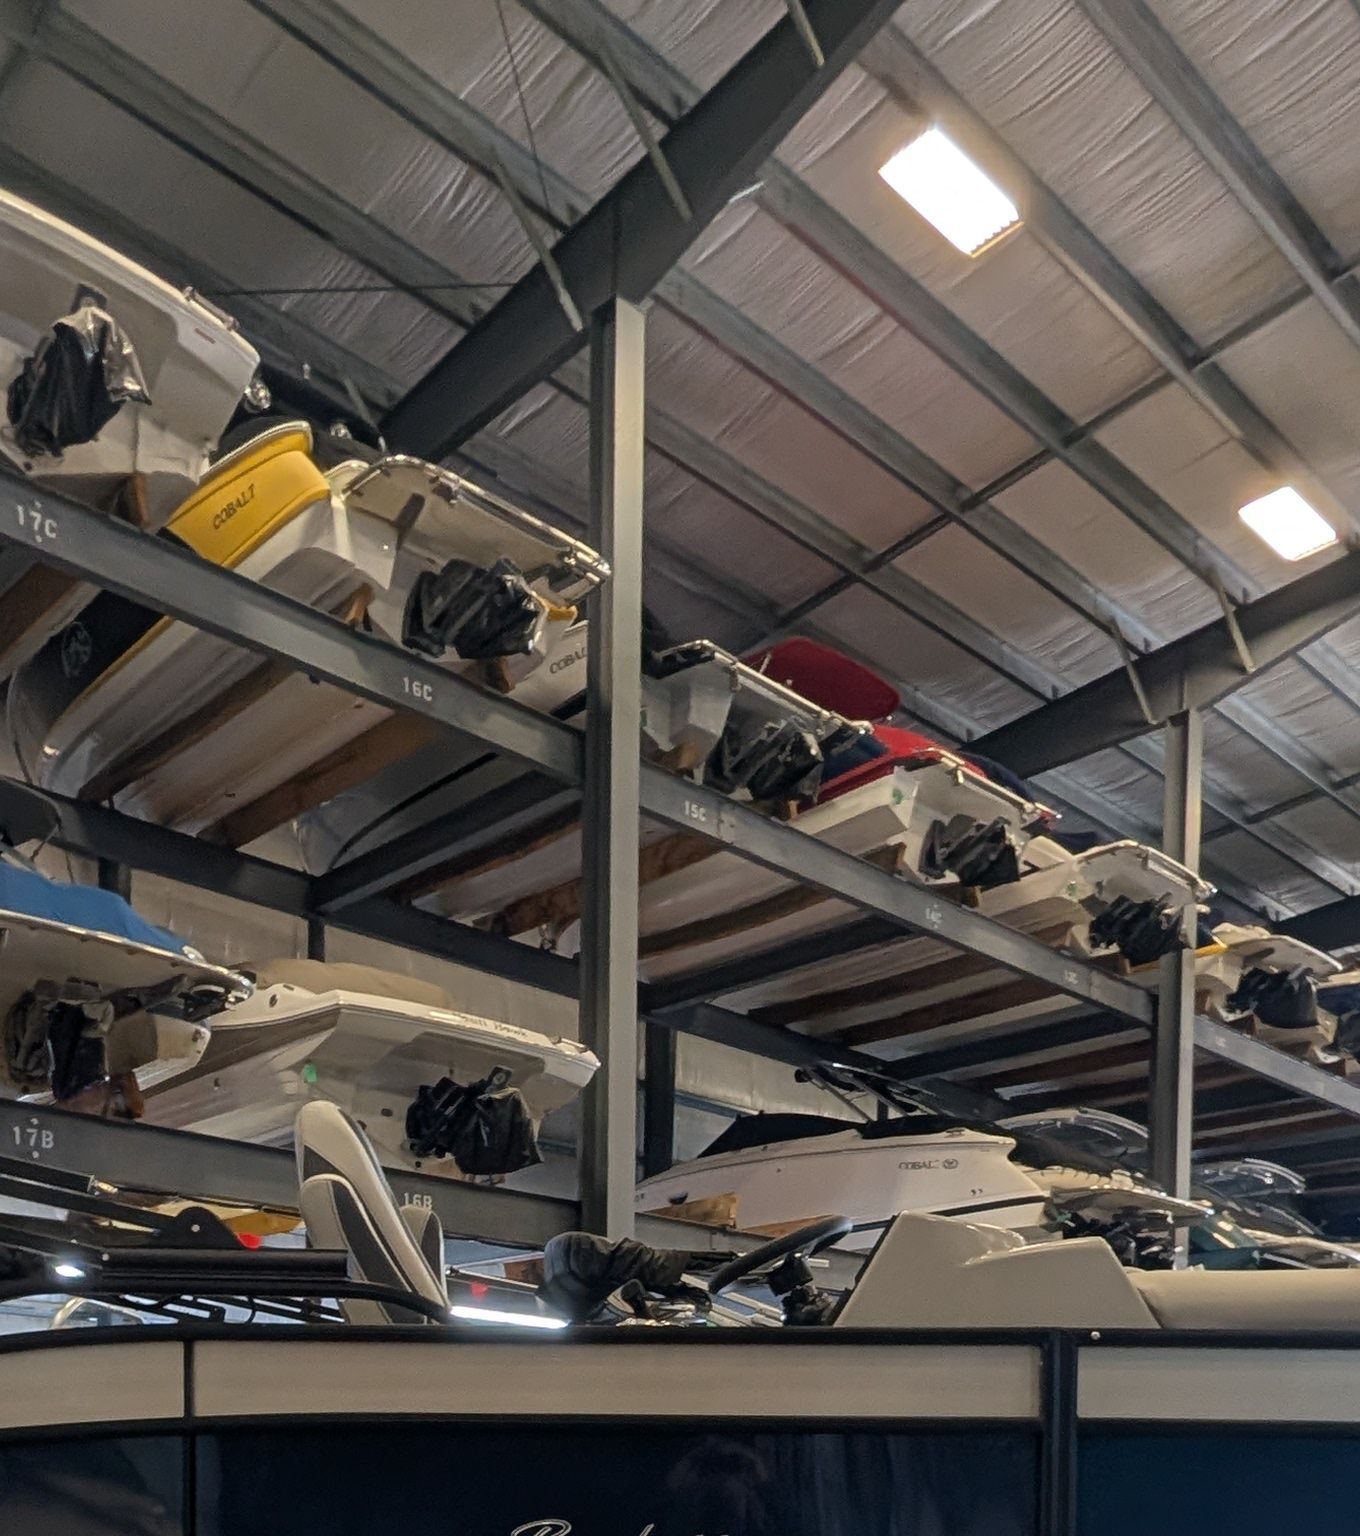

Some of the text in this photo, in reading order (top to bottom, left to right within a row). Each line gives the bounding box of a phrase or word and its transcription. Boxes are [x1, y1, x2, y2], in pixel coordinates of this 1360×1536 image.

[213, 483, 254, 530] COBALT
[16, 504, 58, 539] 17C
[550, 647, 588, 673] COBAL
[402, 676, 433, 702] 16C
[684, 800, 707, 822] 15C
[12, 1125, 55, 1149] 17B
